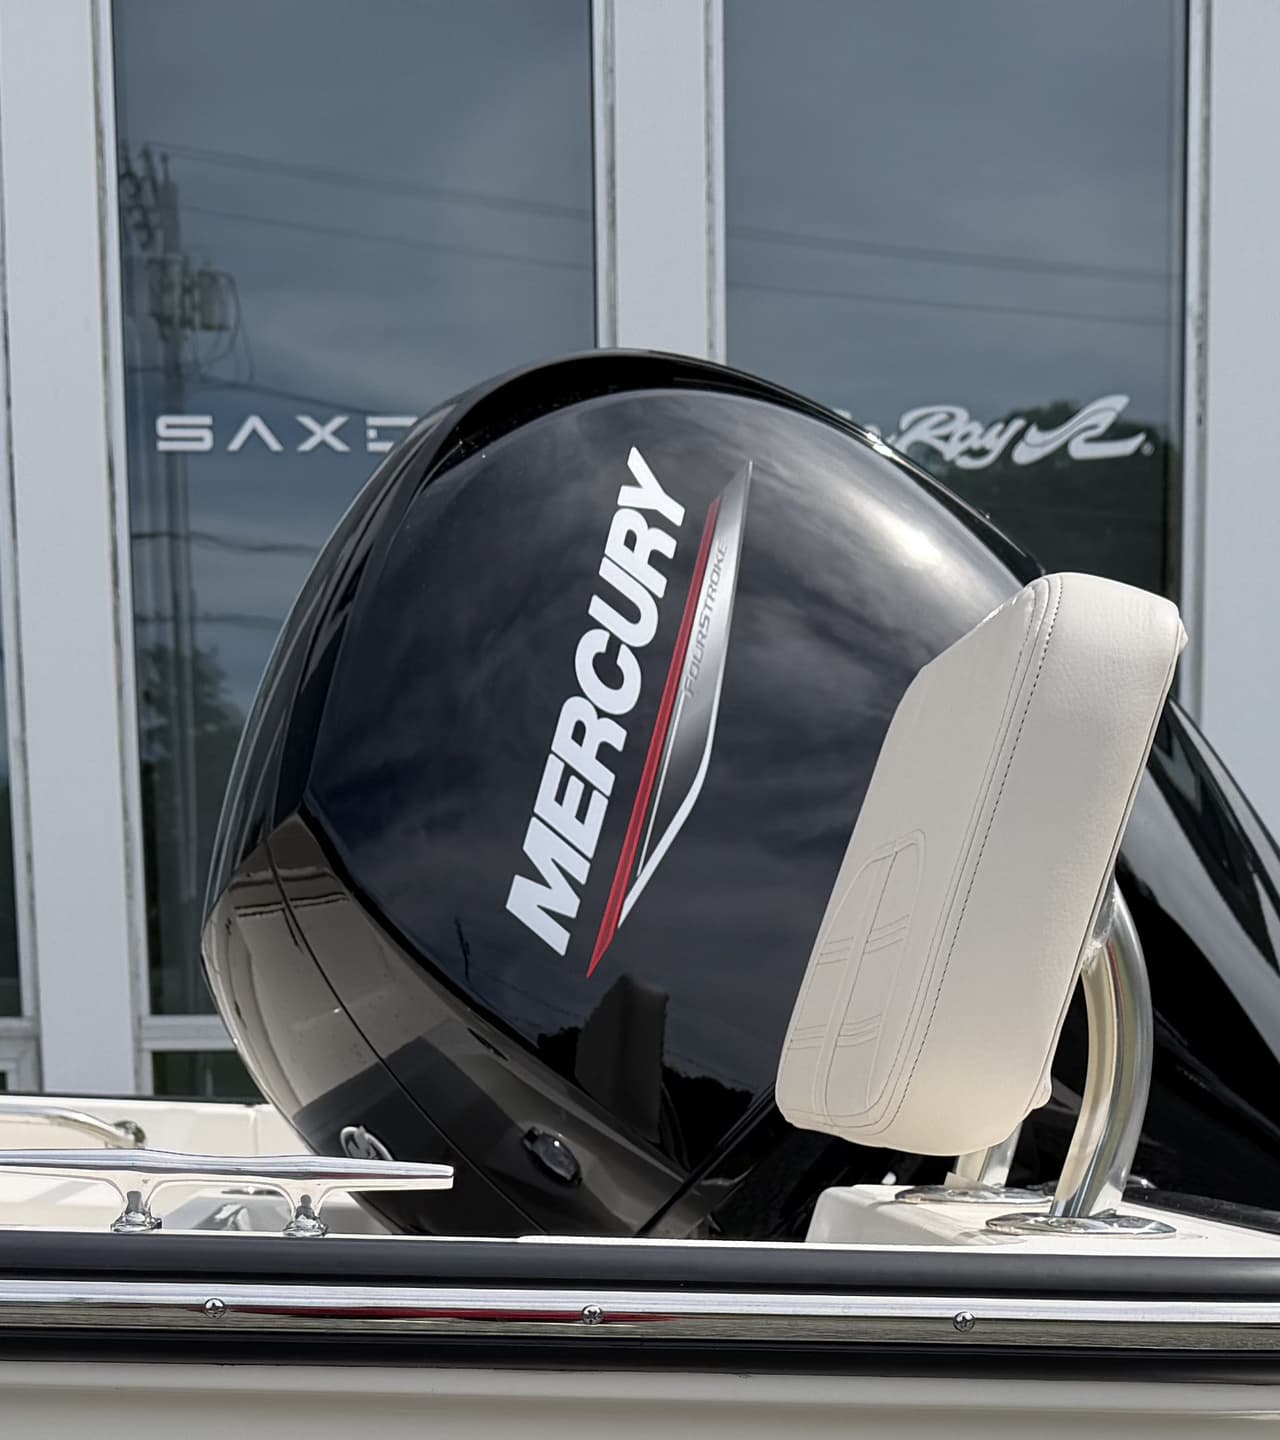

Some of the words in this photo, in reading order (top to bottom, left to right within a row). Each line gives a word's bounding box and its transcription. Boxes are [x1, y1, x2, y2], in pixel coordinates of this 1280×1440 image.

[156, 415, 418, 452] SAXD
[684, 541, 728, 697] FOURSTROKE
[506, 446, 685, 957] MERCURY
